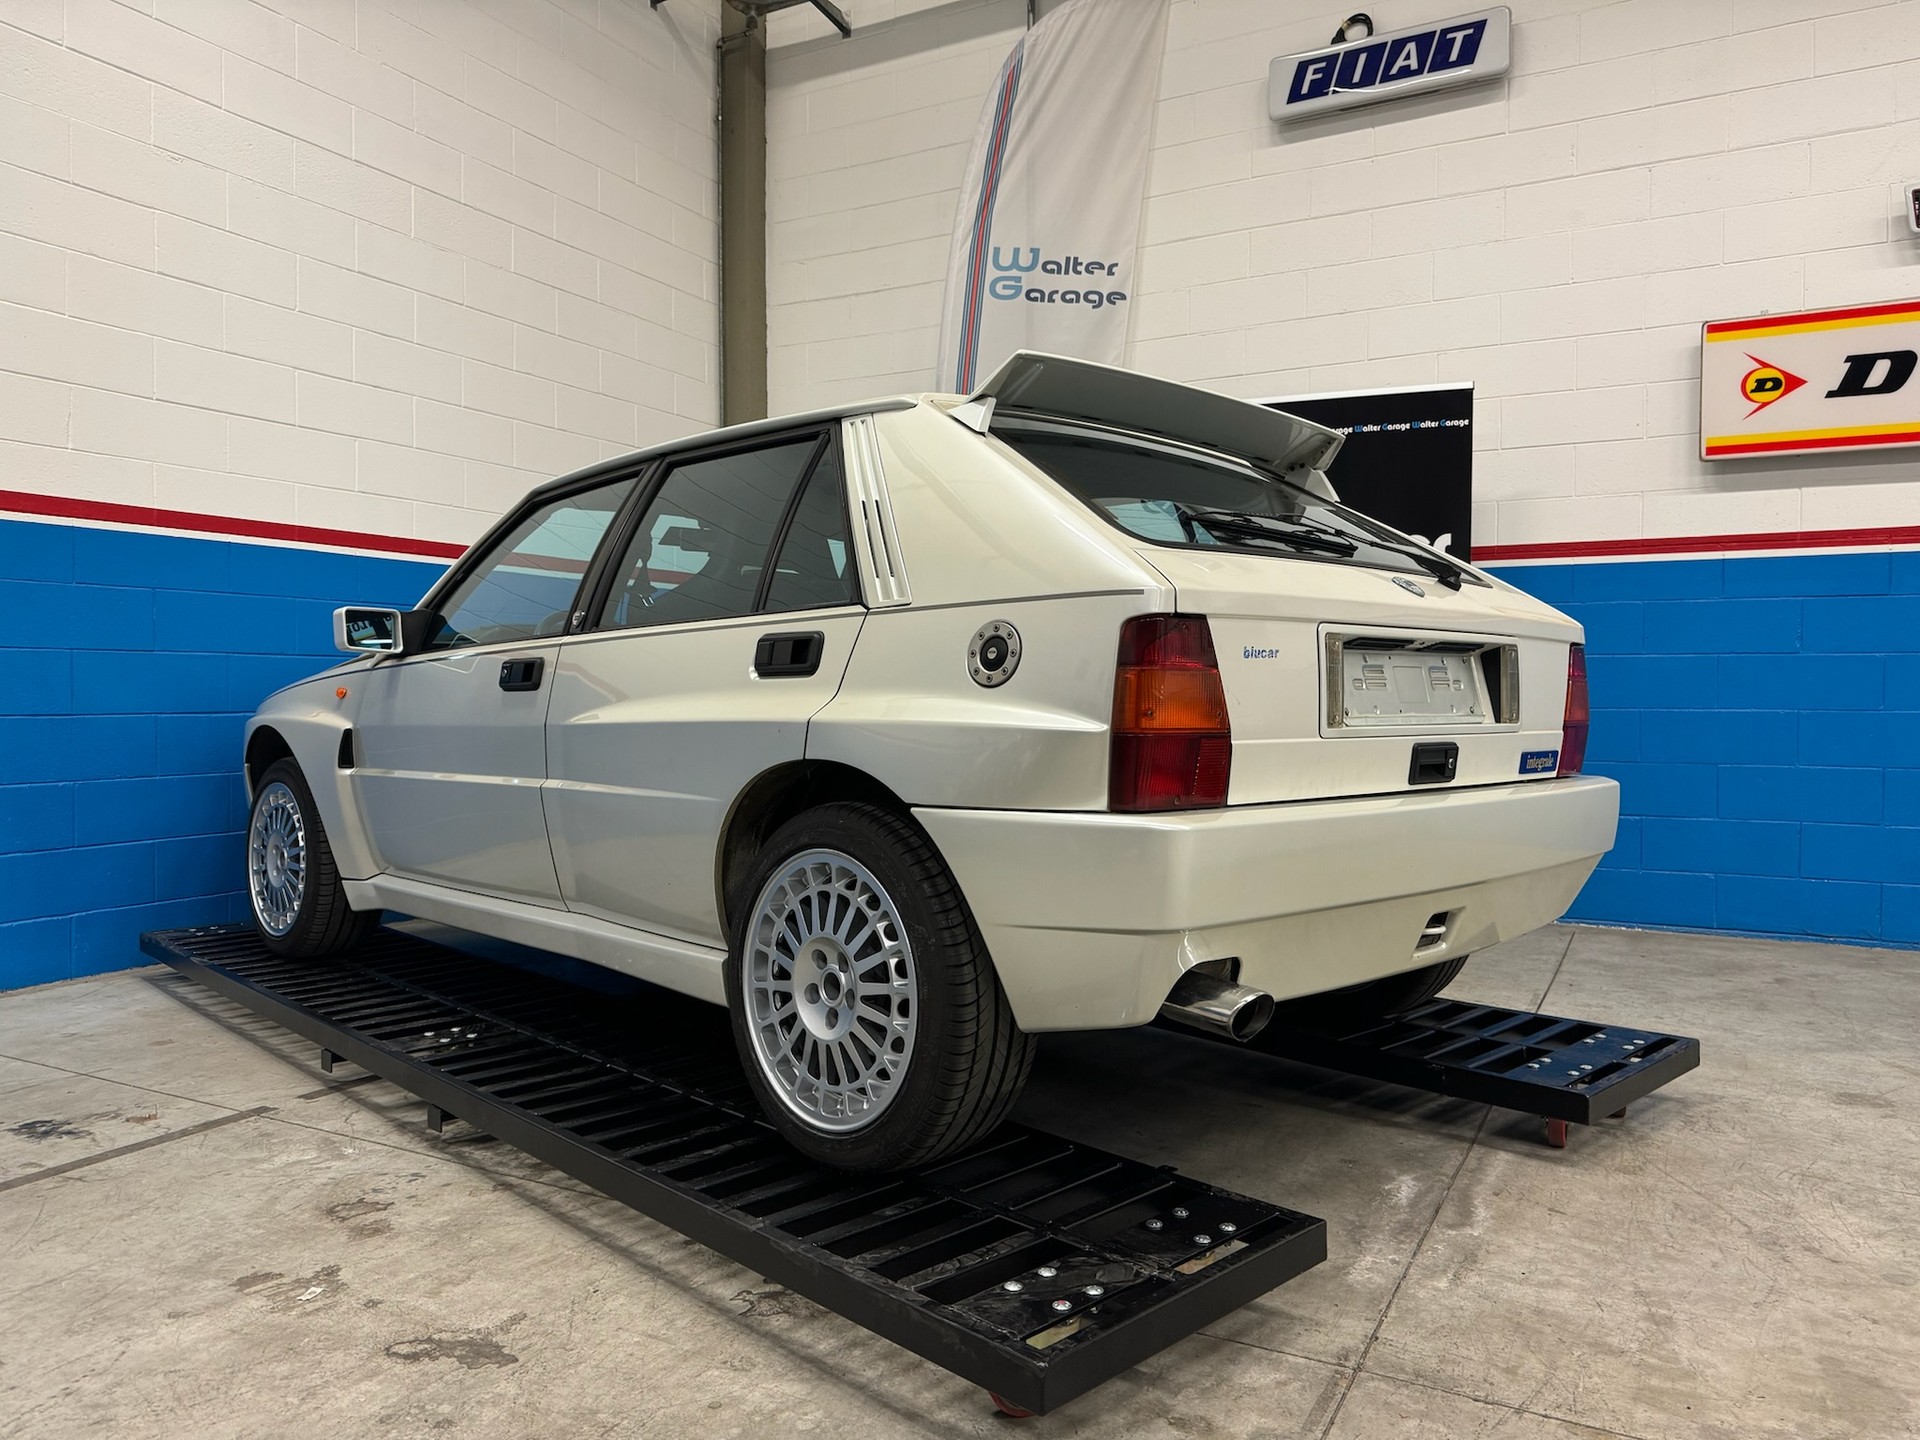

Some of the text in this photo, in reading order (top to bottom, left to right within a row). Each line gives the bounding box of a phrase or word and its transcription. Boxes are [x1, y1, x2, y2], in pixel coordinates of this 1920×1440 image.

[1300, 28, 1474, 95] FIAT
[991, 246, 1119, 277] Walter
[988, 275, 1128, 310] Garage
[1354, 424, 1382, 433] Walter
[1382, 422, 1411, 432] Garage
[1411, 420, 1440, 429] Walter
[1440, 418, 1470, 428] Garage
